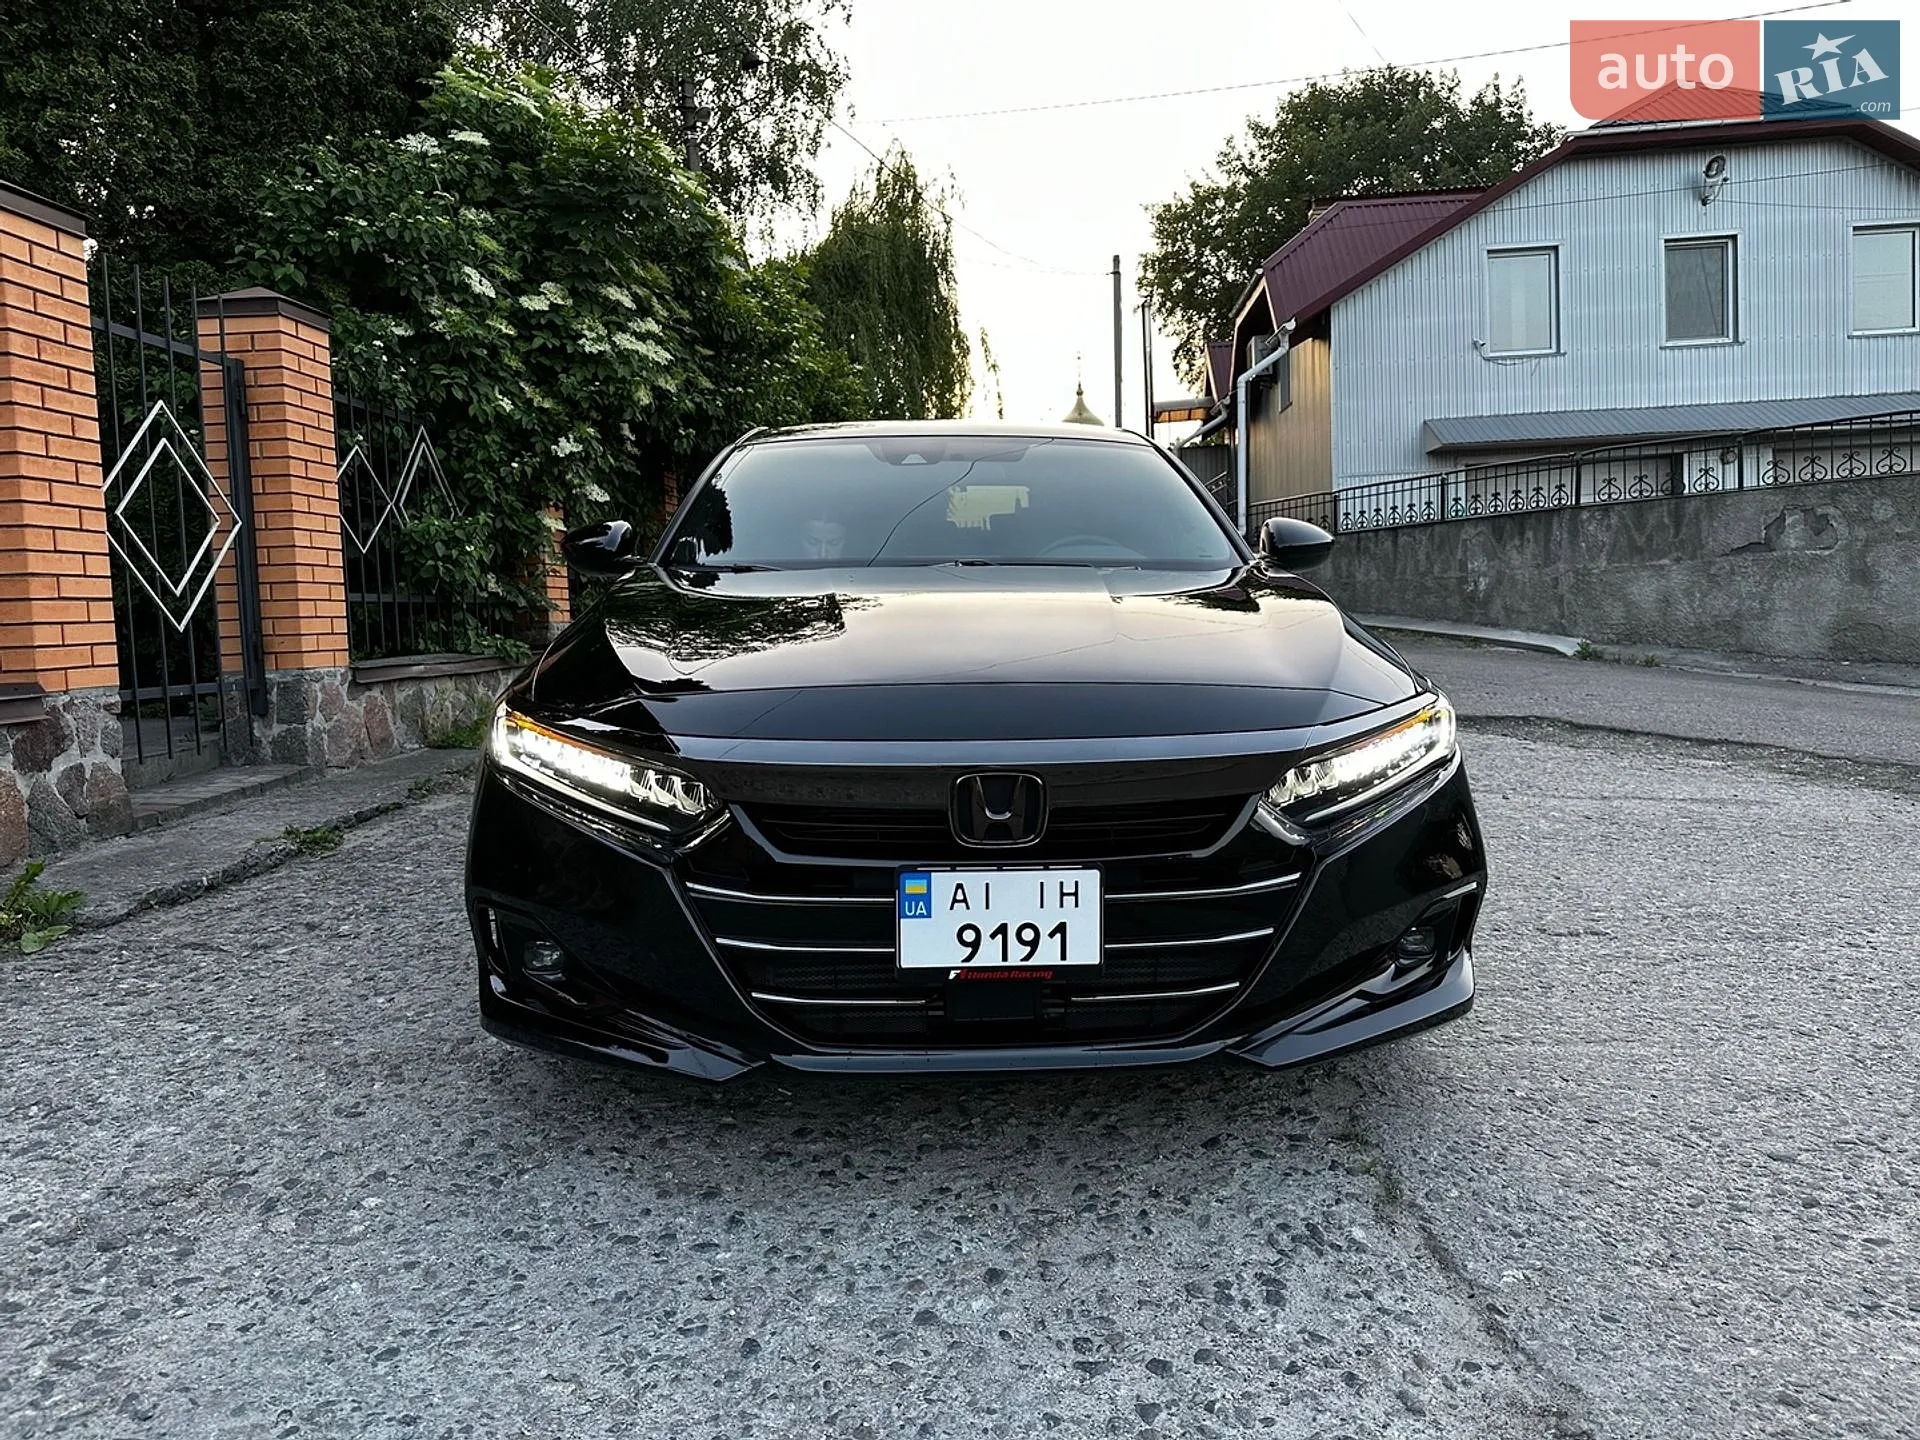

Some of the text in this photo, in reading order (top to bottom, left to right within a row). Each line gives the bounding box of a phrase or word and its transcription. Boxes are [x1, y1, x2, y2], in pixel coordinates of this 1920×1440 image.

[905, 901, 927, 916] UA
[949, 880, 1079, 911] AI IH
[956, 921, 1067, 963] 9191
